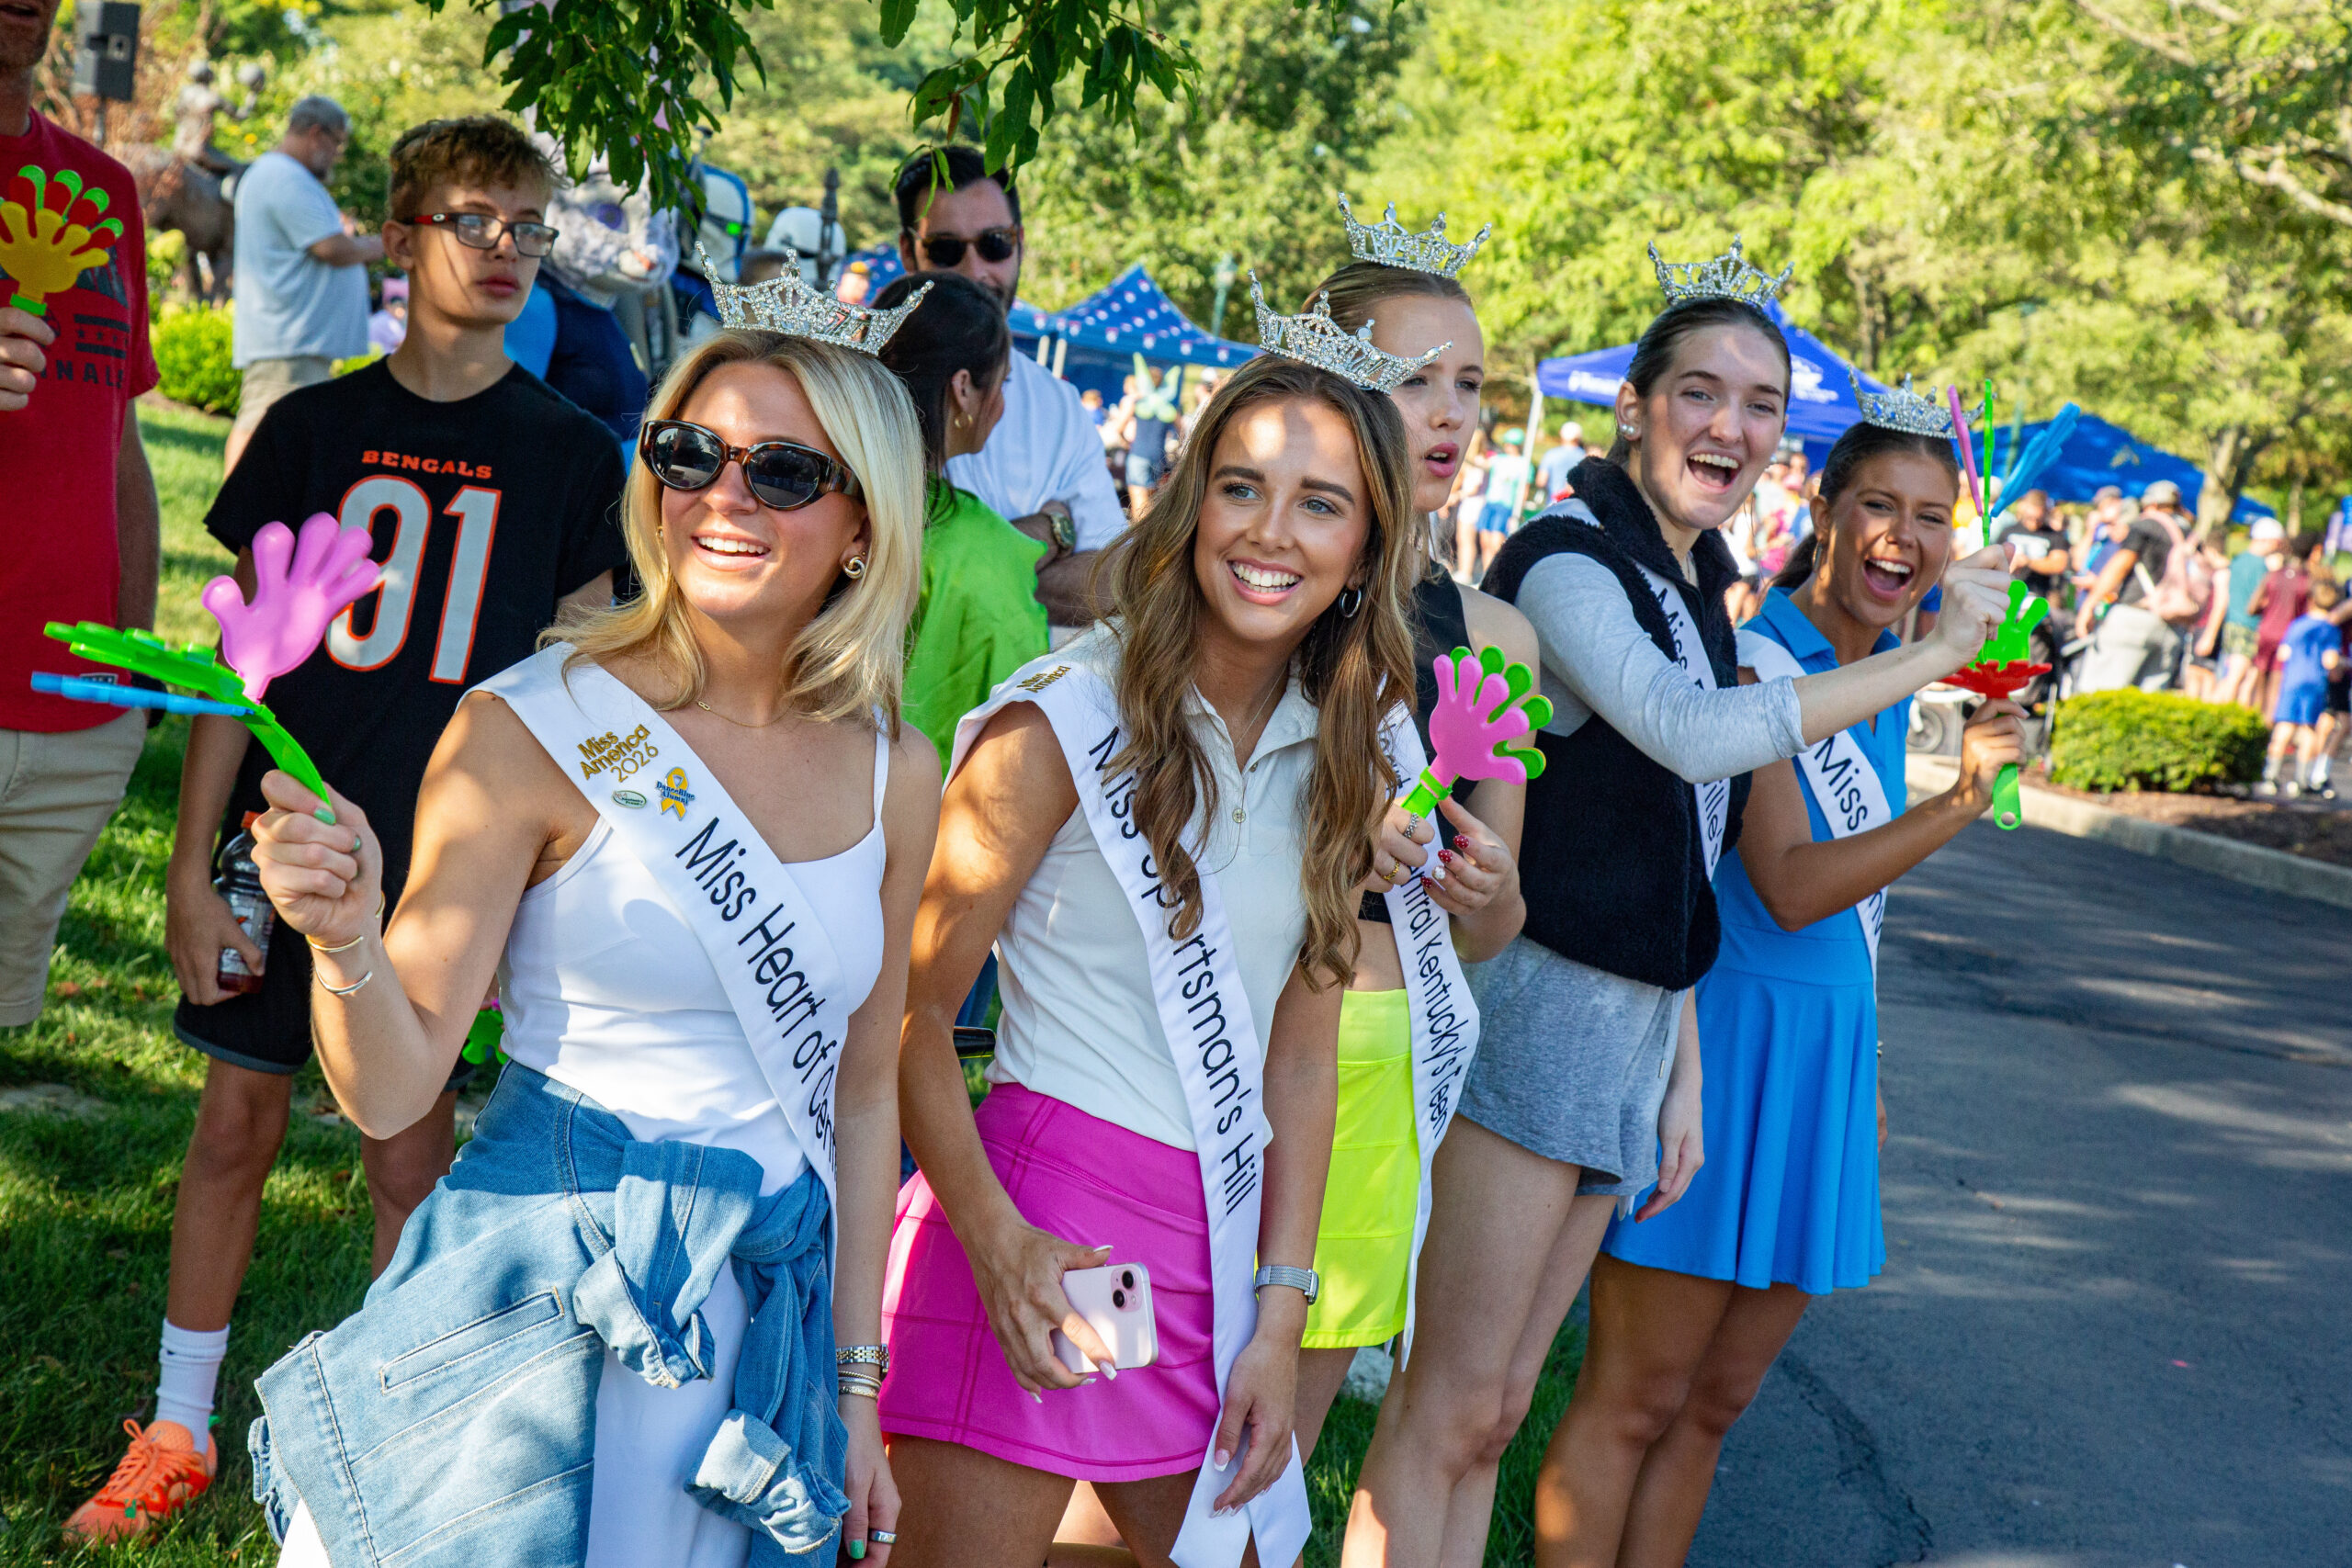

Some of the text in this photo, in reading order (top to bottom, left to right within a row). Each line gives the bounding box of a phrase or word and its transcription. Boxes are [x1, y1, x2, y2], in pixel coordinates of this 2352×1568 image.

[362, 450, 492, 479] BENGALS
[324, 474, 503, 685] 91
[577, 731, 618, 760] Miss
[580, 724, 650, 780] America
[610, 741, 659, 783] 2026
[655, 780, 696, 800] DanceBlue
[661, 789, 688, 806] Alumni
[1814, 735, 1868, 831] Miss
[674, 817, 756, 922] Miss
[738, 903, 826, 1038] Heart
[793, 1031, 837, 1084] of
[1416, 931, 1468, 1077] Kentucky's
[1430, 1064, 1463, 1139] Teen
[1221, 1132, 1257, 1216] Hill
